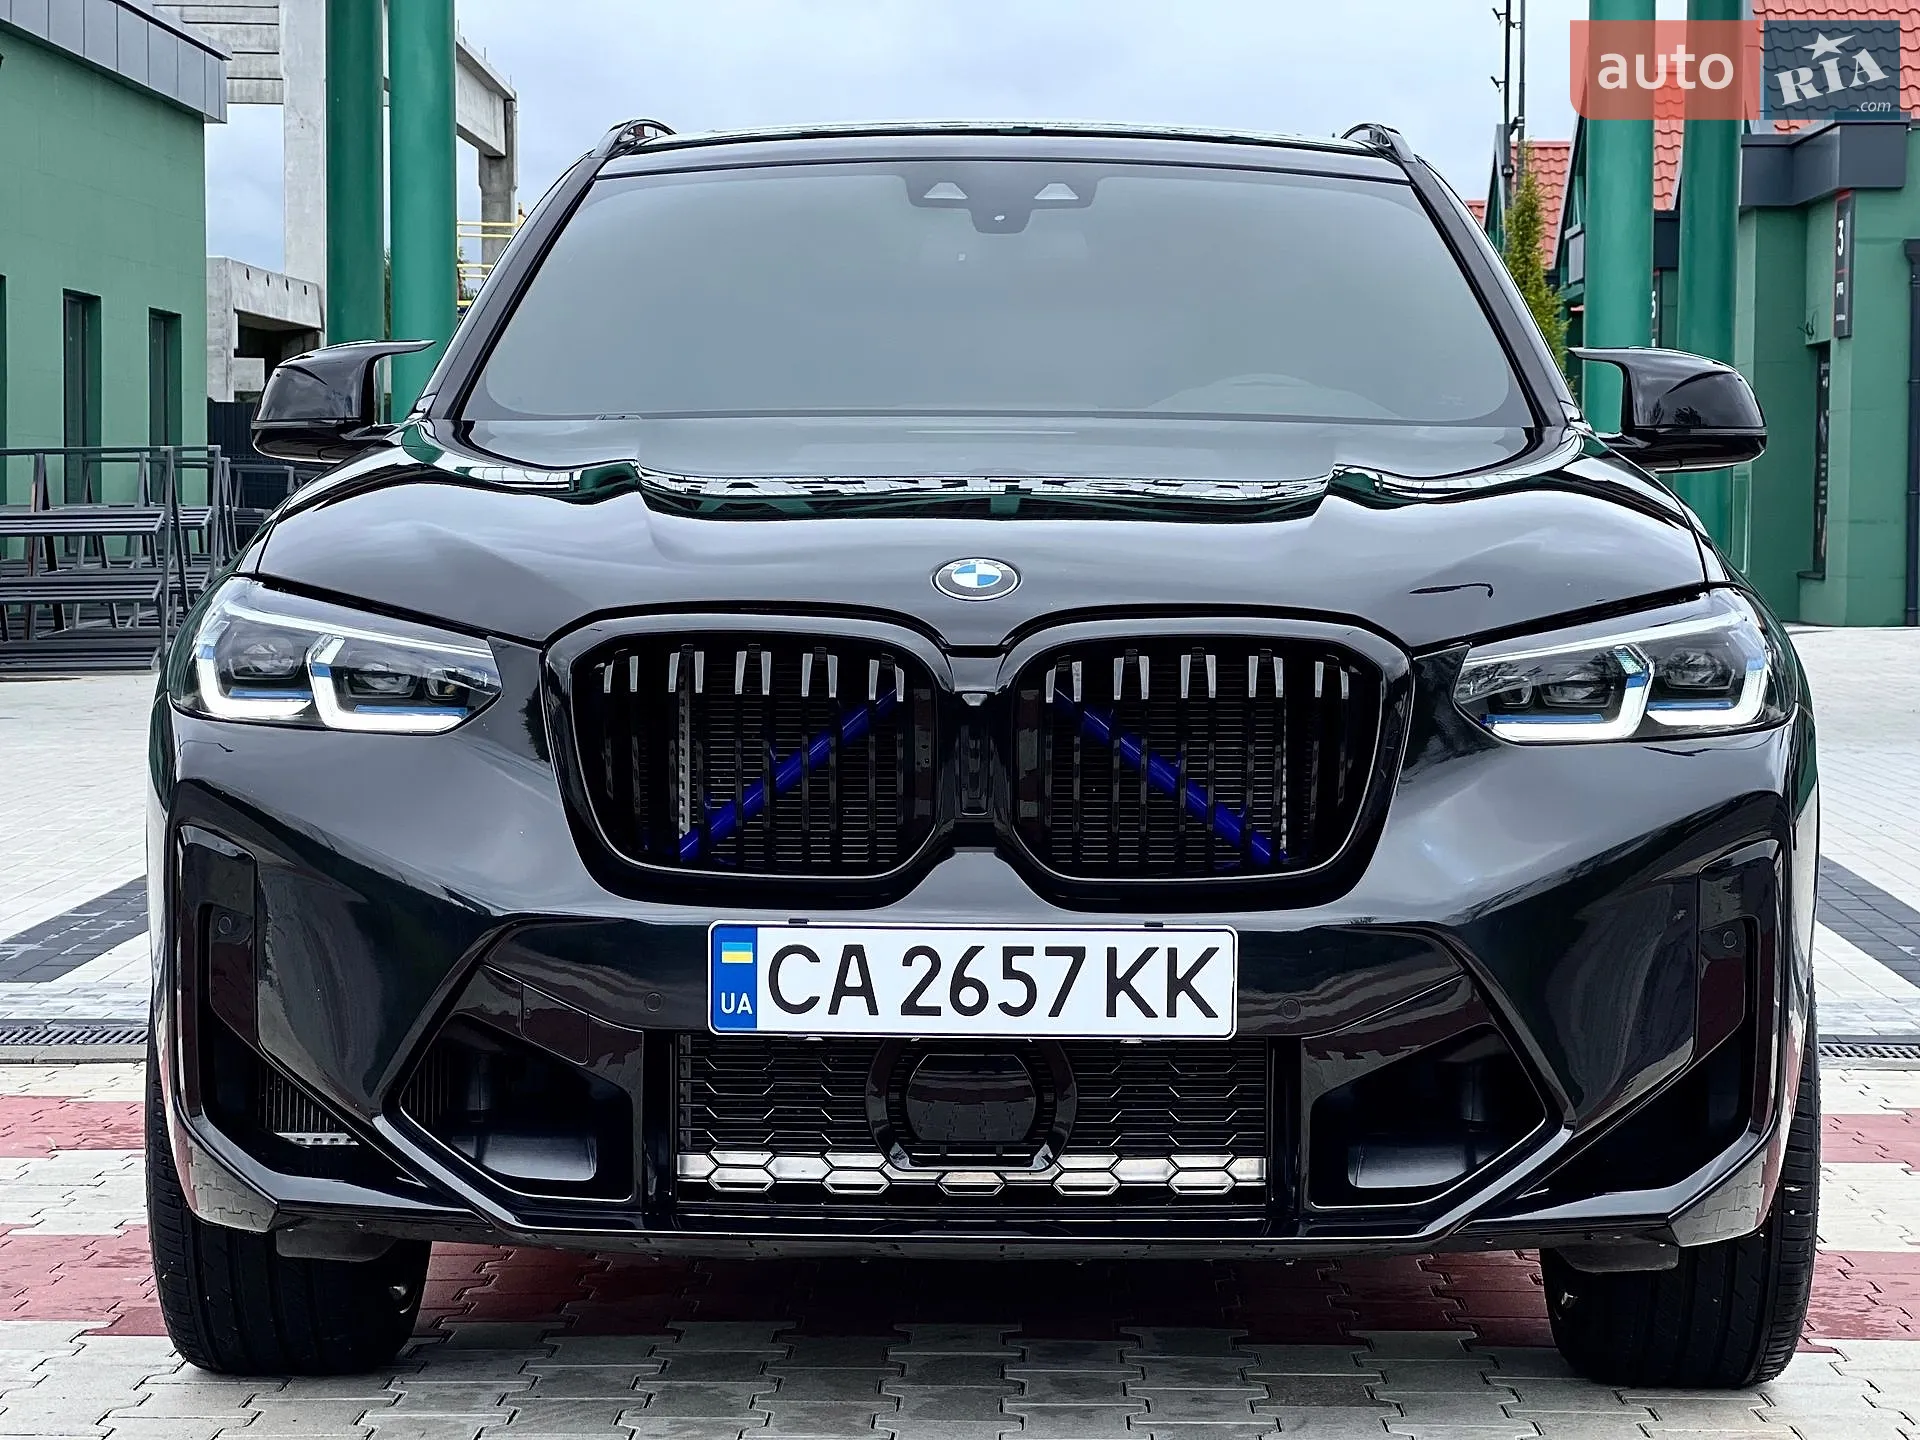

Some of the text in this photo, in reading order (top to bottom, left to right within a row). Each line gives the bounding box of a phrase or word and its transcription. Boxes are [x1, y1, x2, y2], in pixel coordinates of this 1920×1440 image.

[1837, 219, 1844, 257] 3
[768, 944, 1220, 1018] CA 2657 KK
[720, 991, 753, 1015] UA
